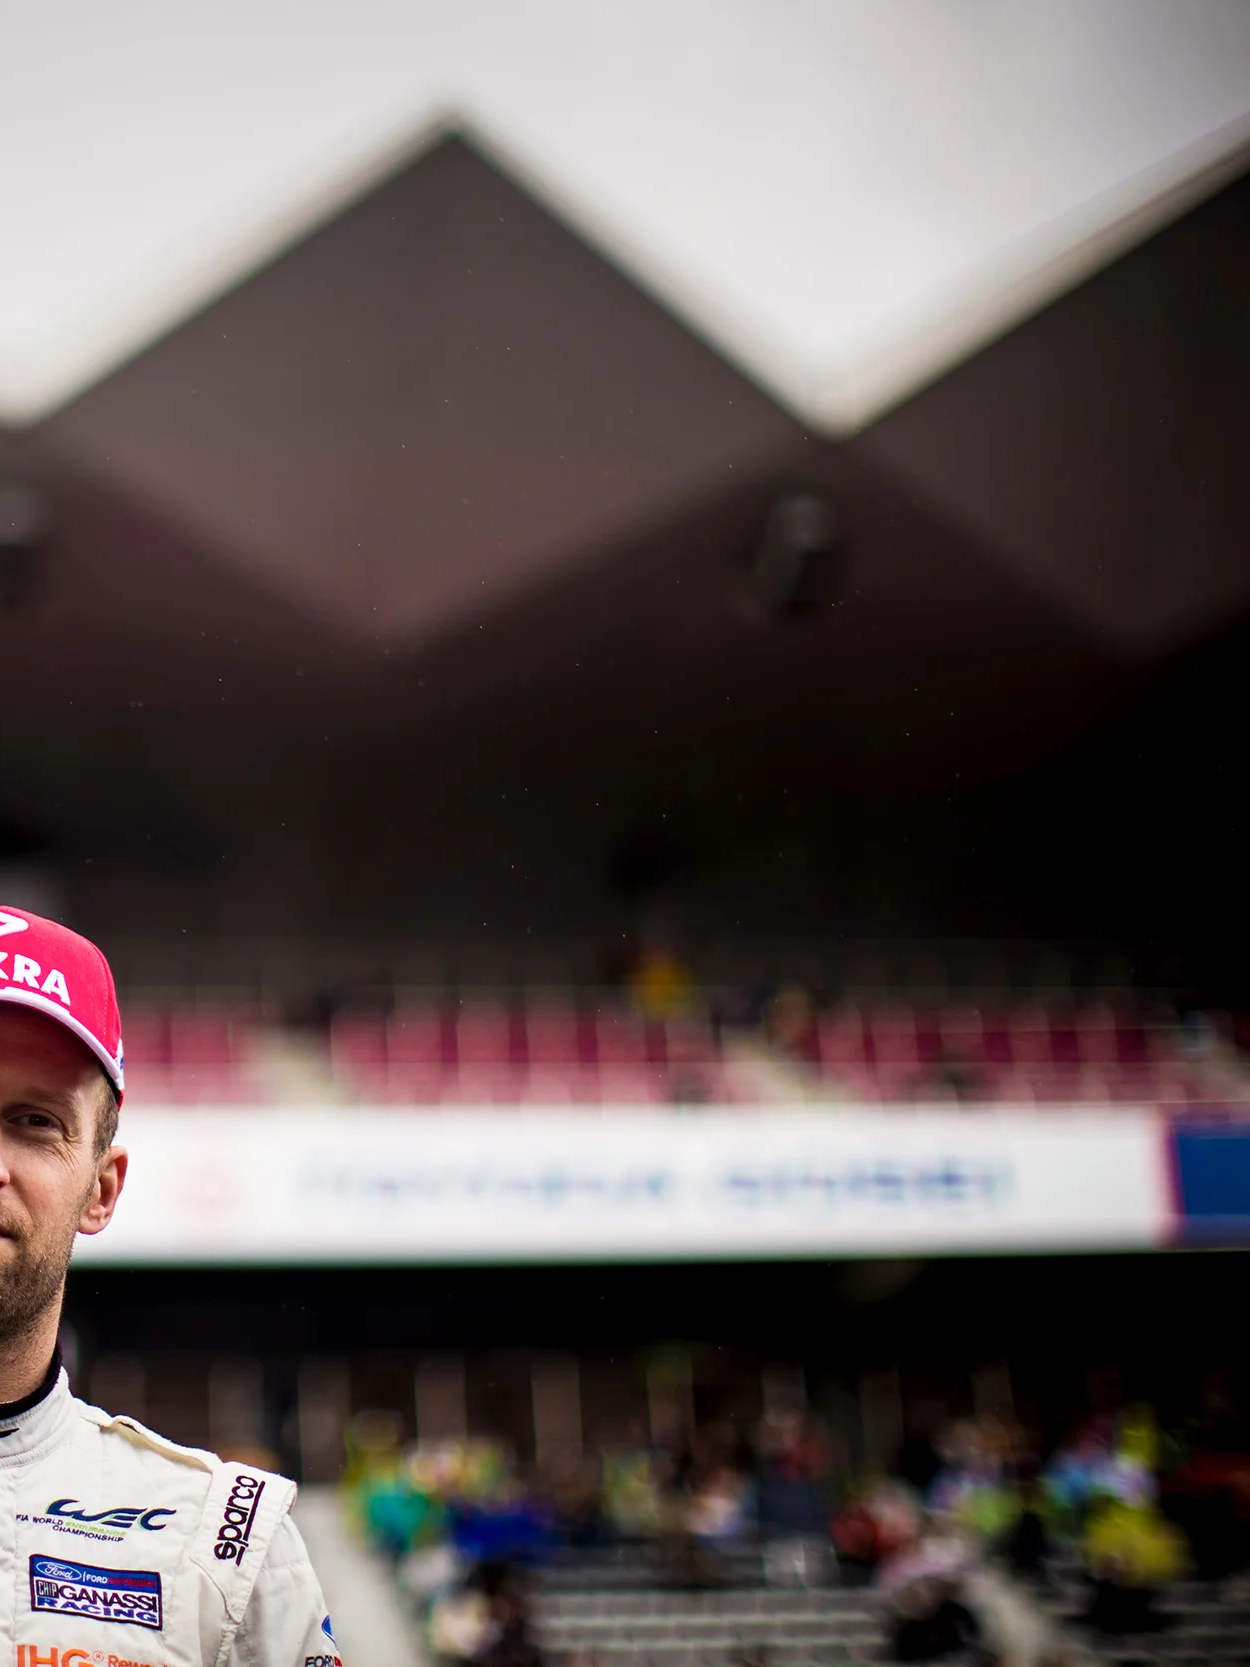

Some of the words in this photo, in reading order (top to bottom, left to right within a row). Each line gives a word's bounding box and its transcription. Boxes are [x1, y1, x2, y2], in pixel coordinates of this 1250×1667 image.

[16, 1514, 29, 1522] FIA
[32, 1516, 63, 1526] WORLD
[45, 1498, 177, 1531] WEC
[214, 1475, 261, 1562] sparco
[52, 1525, 124, 1542] CHAMPIONSHIP
[43, 1563, 74, 1579] Ford
[86, 1574, 108, 1584] FORD
[37, 1580, 58, 1597] CHIP
[59, 1584, 158, 1613] GANASSI
[36, 1597, 158, 1624] RACING
